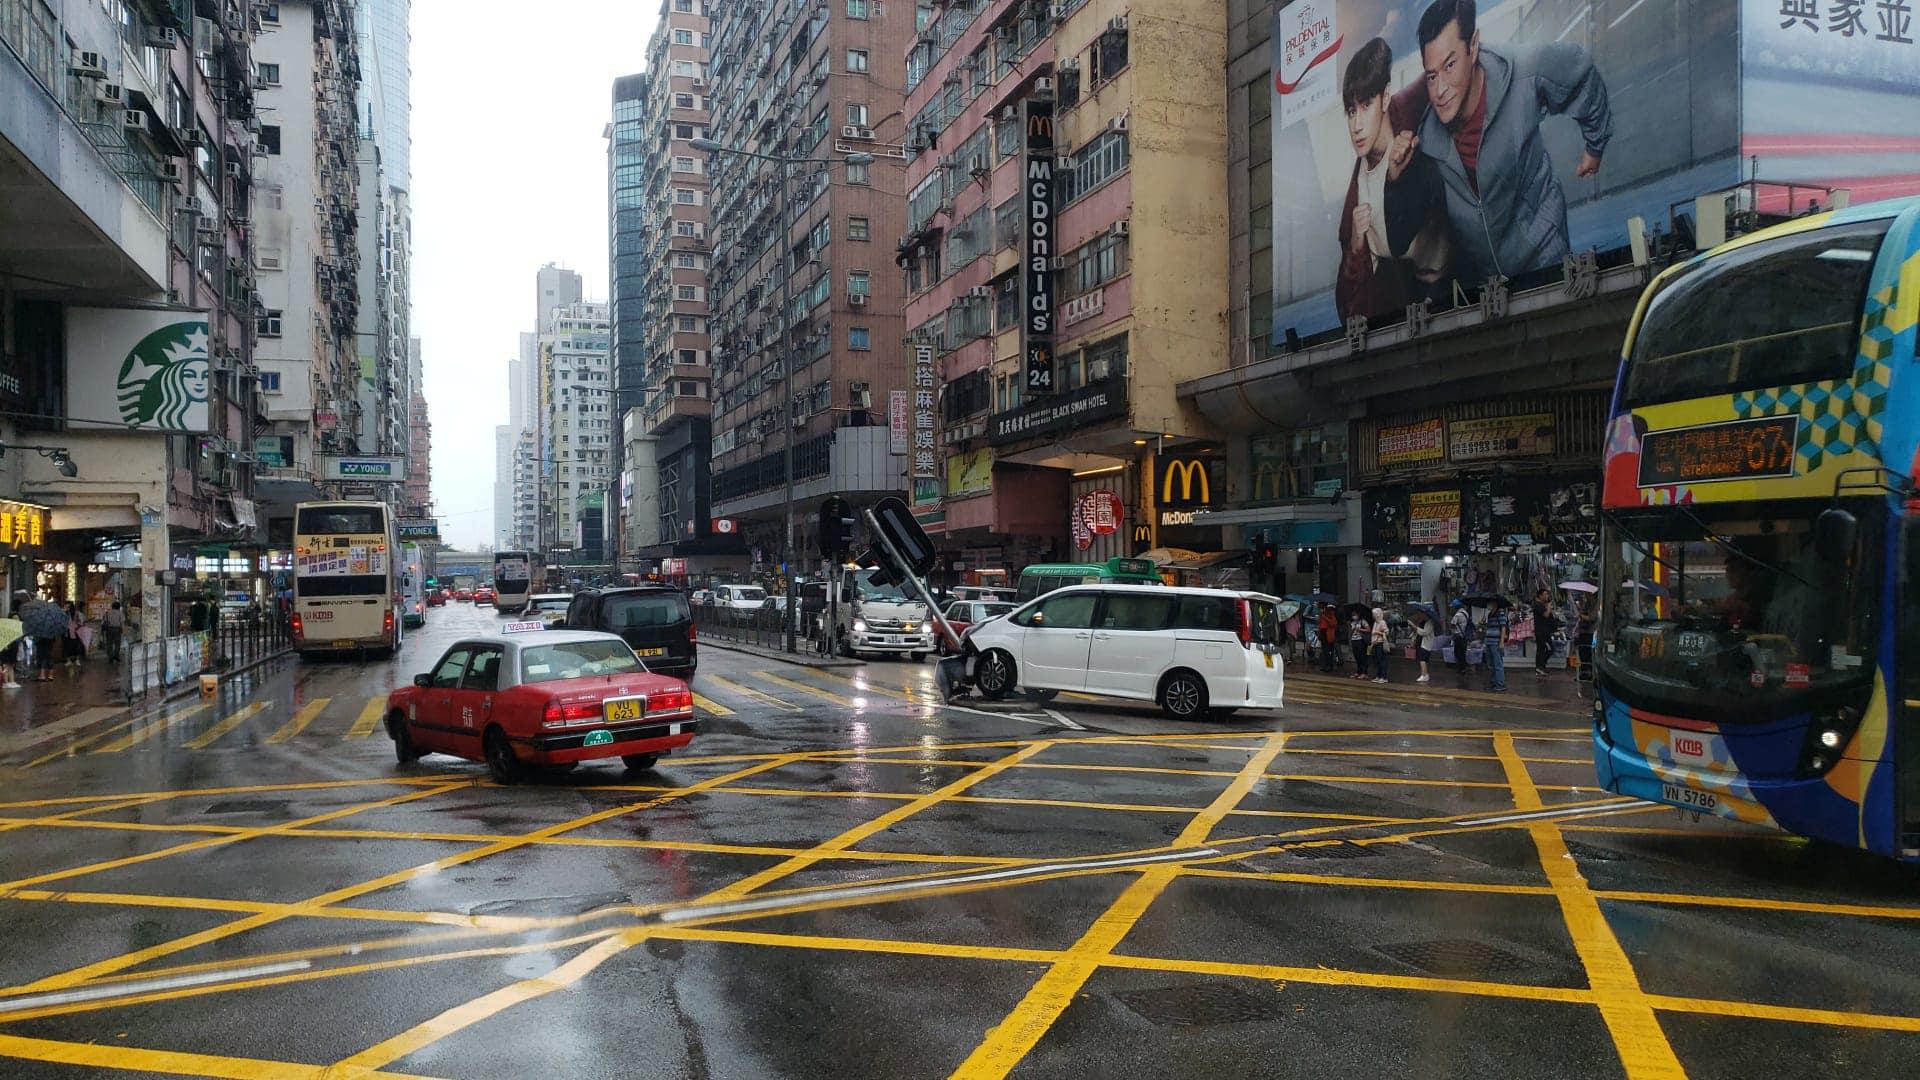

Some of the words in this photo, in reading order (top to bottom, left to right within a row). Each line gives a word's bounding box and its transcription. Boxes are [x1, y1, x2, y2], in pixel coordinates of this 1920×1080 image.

[1286, 16, 1330, 53] PRUDENTIAL
[1028, 160, 1051, 332] McDonald's
[1029, 370, 1050, 386] 24
[1052, 404, 1071, 420] BLACK
[1070, 398, 1088, 414] SWAN
[1088, 393, 1108, 410] HOTEL
[359, 463, 386, 473] YONEX
[407, 527, 433, 536] YONEX
[507, 622, 541, 631] TAXI
[615, 701, 630, 710] VU
[613, 710, 634, 719] 623
[1675, 737, 1704, 757] KMB
[1664, 785, 1680, 801] VN
[1684, 789, 1717, 809] 5786
